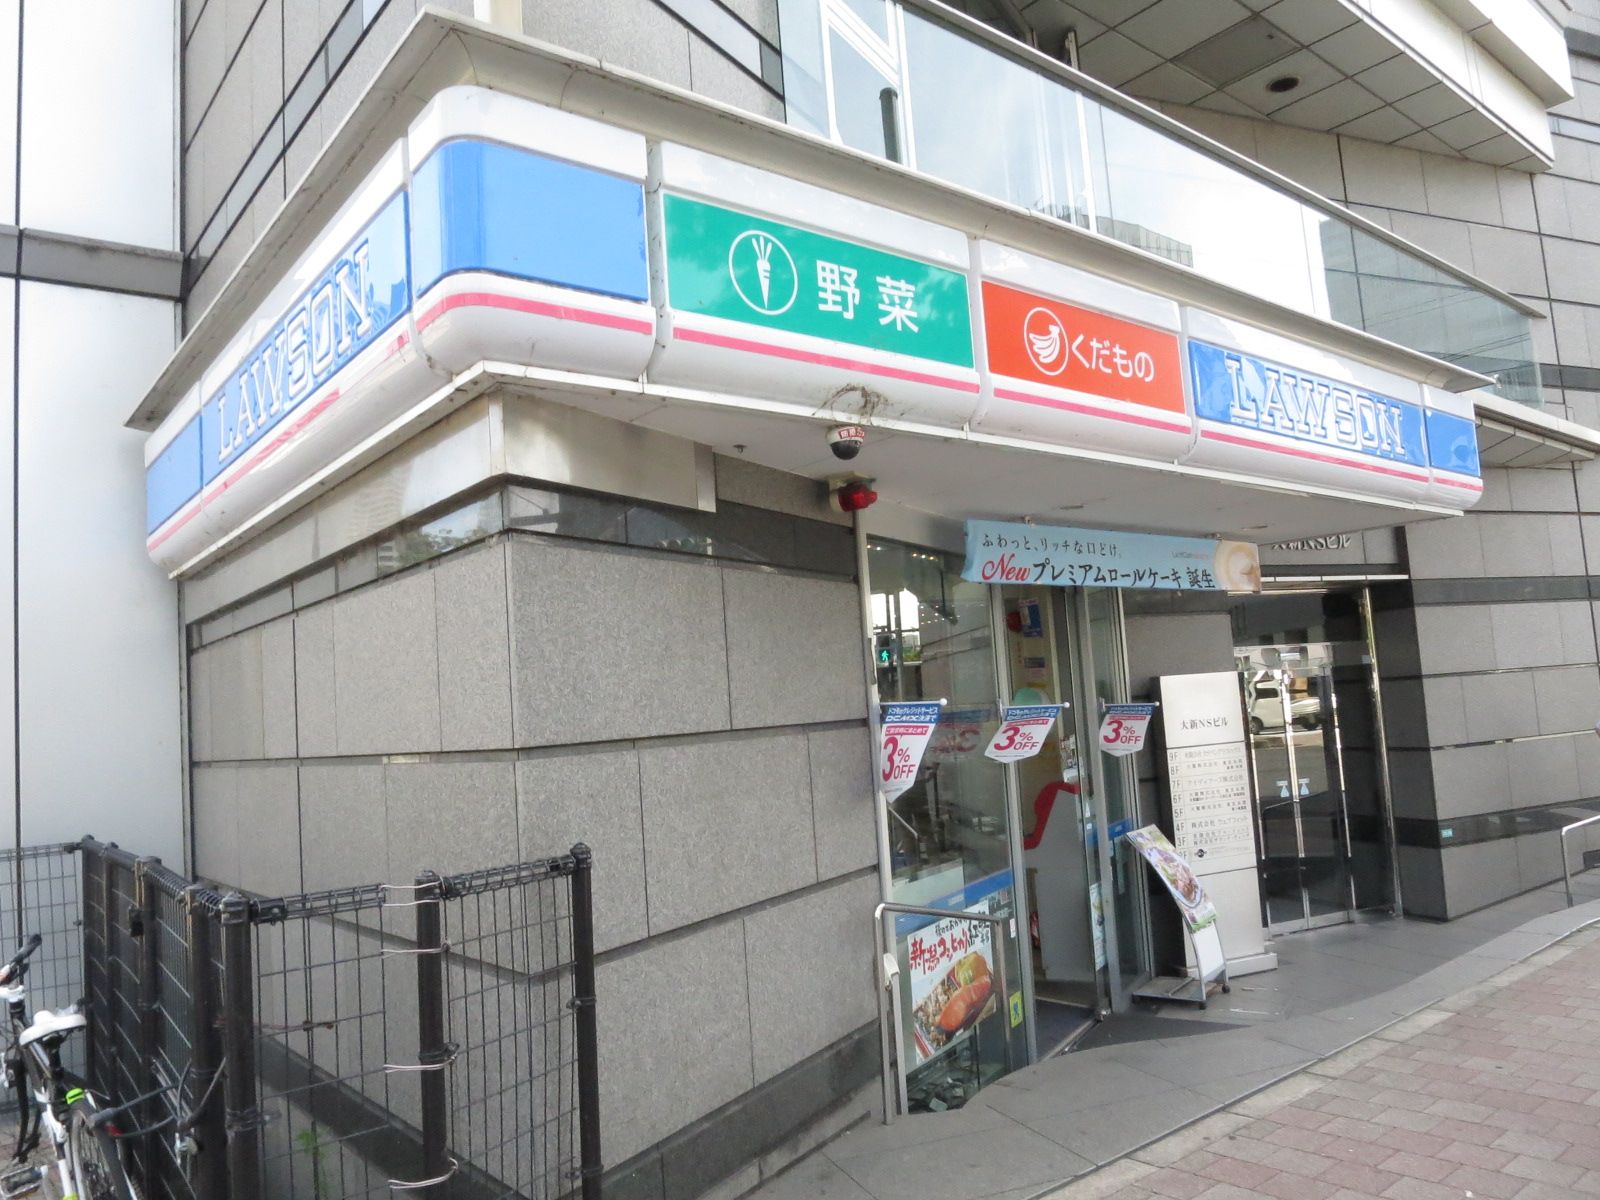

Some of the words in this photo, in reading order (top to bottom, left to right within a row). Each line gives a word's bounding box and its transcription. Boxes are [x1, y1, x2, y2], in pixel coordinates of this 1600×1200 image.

[815, 259, 919, 334] 野菜
[218, 237, 372, 463] LAWSON
[1071, 333, 1156, 382] くだもの
[1225, 353, 1407, 457] LAWSON
[981, 553, 1031, 581] New
[1032, 557, 1182, 589] プレミアムロールケーキ
[1186, 566, 1216, 589] 誕生
[1013, 741, 1040, 751] OFF
[1120, 735, 1142, 745] OFF
[893, 764, 916, 780] OFF
